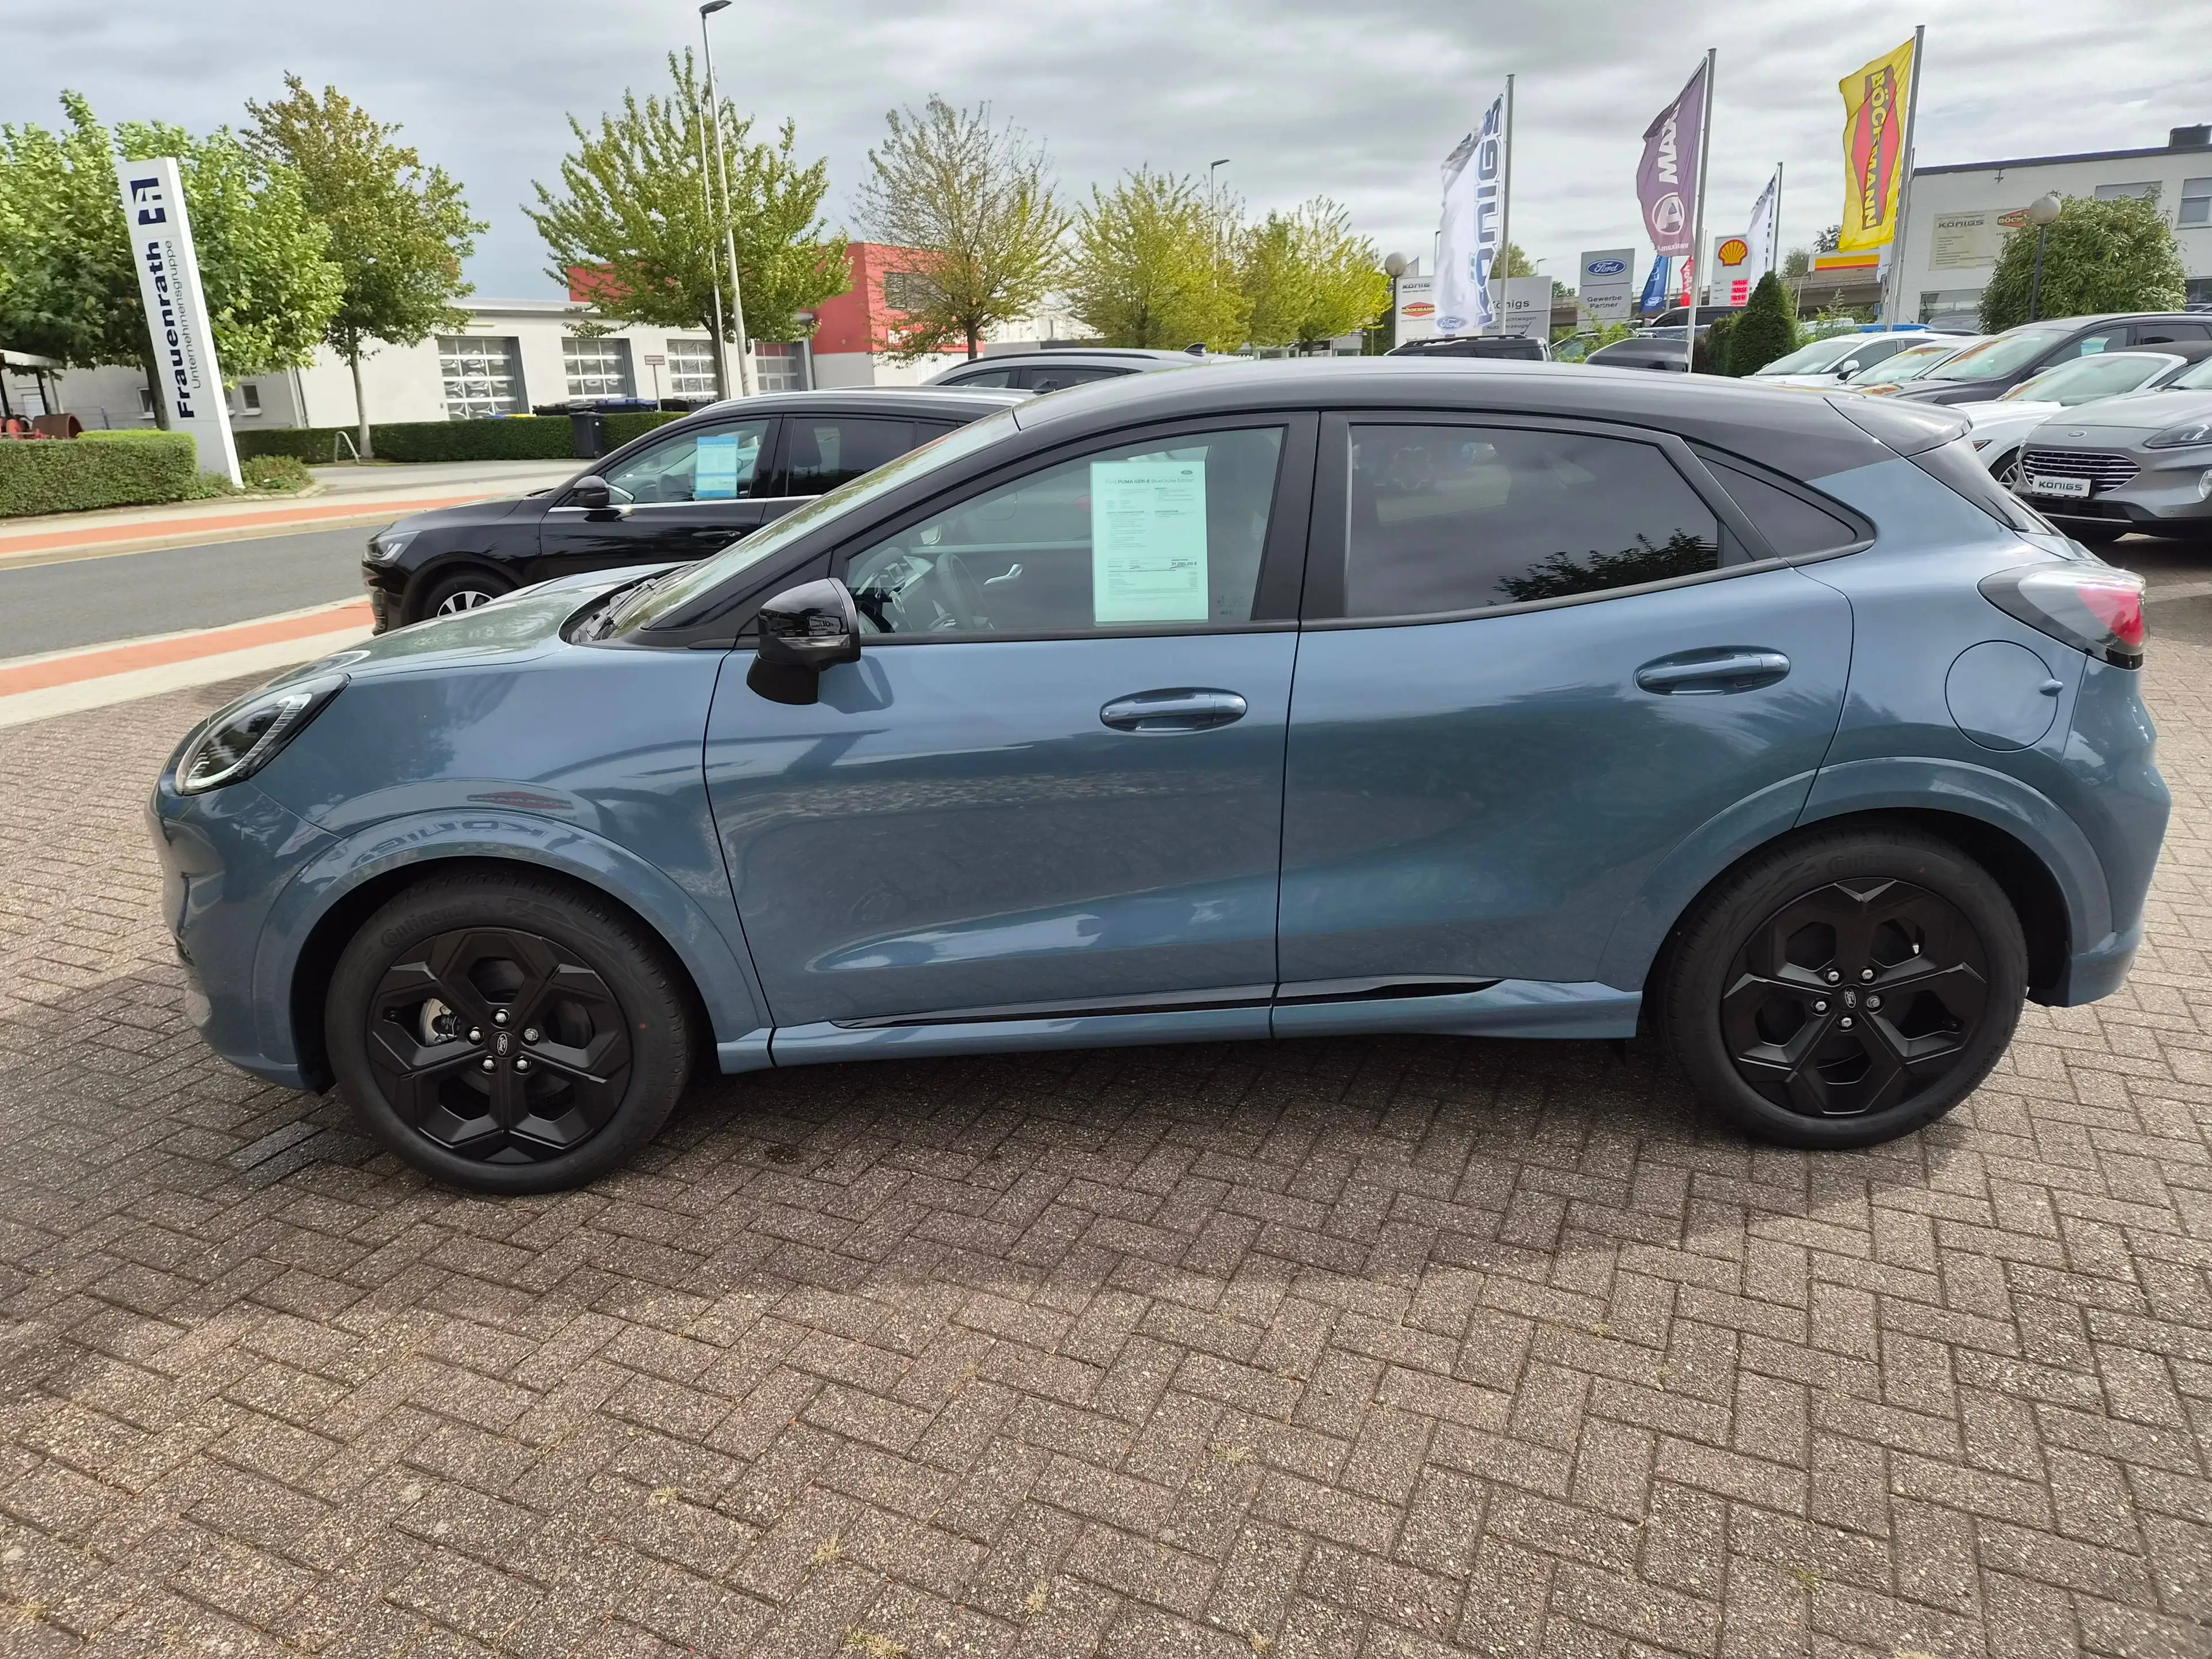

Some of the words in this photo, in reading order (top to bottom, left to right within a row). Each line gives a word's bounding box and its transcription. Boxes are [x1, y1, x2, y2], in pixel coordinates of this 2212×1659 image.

[1938, 219, 1985, 229] KÖNIGS
[1593, 262, 1619, 273] Ford
[164, 240, 202, 390] Unternehmensgruppe
[1440, 317, 1462, 329] Ford
[146, 241, 195, 419] Frauenrath
[2038, 479, 2084, 491] KÖNIGS
